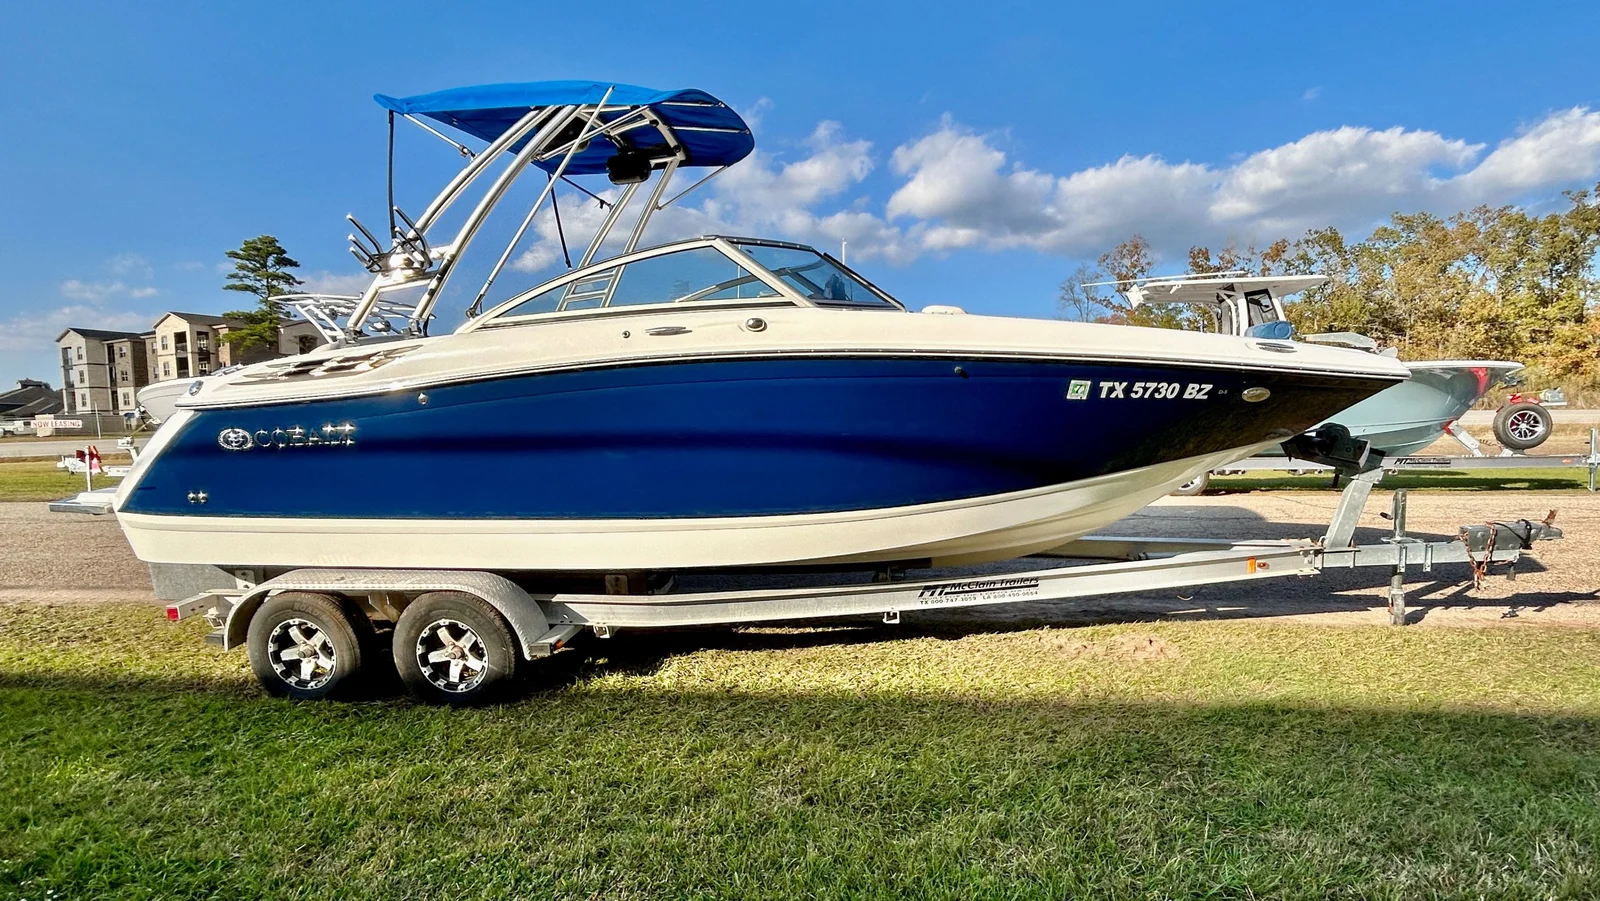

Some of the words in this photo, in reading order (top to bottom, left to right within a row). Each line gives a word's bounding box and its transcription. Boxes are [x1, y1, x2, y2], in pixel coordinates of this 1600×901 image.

[1099, 382, 1128, 398] TX
[1130, 382, 1180, 399] 5730
[1183, 384, 1213, 399] BZ
[254, 423, 354, 447] COBALT
[950, 580, 996, 591] McClain
[1000, 576, 1039, 586] Trailers
